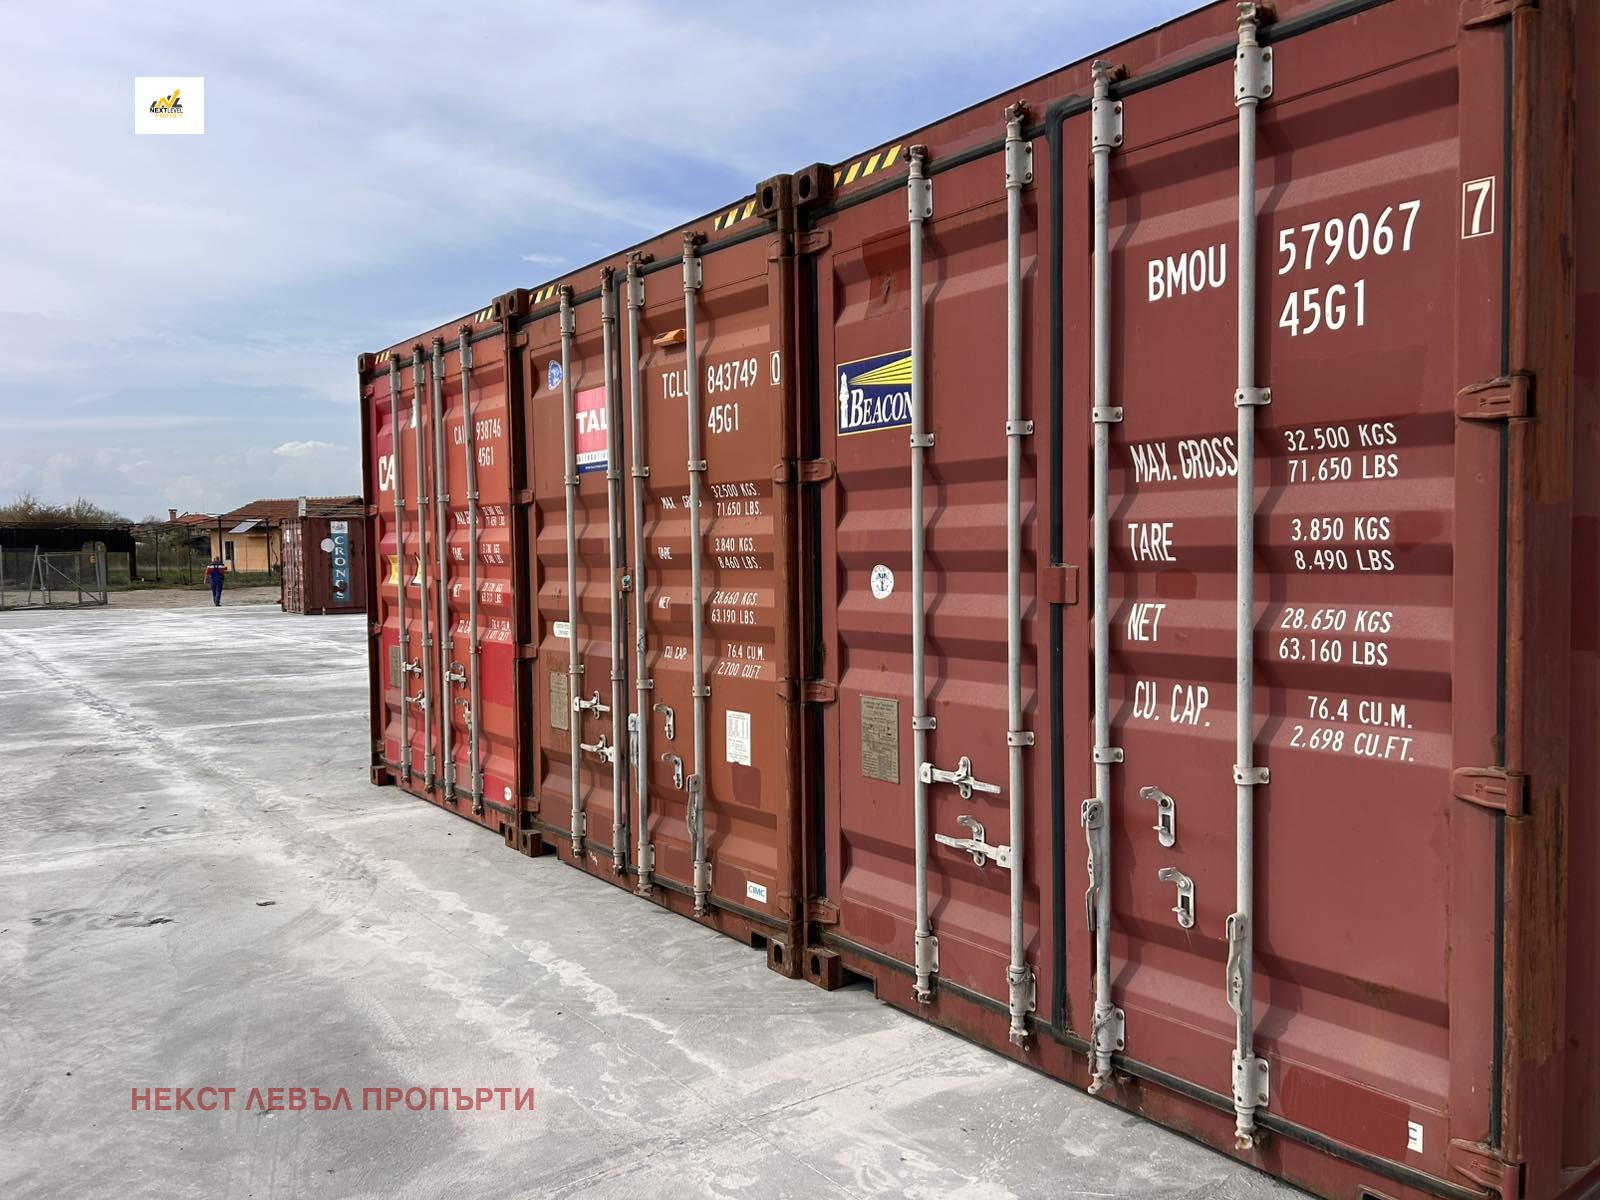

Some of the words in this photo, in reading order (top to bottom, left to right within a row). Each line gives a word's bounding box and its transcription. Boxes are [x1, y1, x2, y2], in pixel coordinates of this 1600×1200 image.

[1278, 199, 1421, 276] 579067
[1465, 179, 1491, 236] 7
[1148, 243, 1227, 302] BMOU
[1278, 279, 1366, 337] 45G1
[707, 357, 758, 394] 843749
[475, 416, 502, 441] 938746
[575, 407, 608, 435] TAL
[707, 402, 740, 434] 45G1
[1358, 423, 1397, 447] KGS
[477, 446, 494, 467] 45G1
[1129, 442, 1178, 484] MAX.
[1178, 436, 1239, 480] GROSS
[1362, 454, 1399, 480] LBS
[744, 500, 762, 516] LBS.
[1128, 522, 1176, 562] TARE
[1354, 516, 1391, 541] KGS
[1356, 549, 1395, 571] LBS
[1127, 602, 1166, 642] NET
[1354, 610, 1393, 634] KGS
[1352, 641, 1389, 667] LBS
[1132, 680, 1160, 721] CU.
[1169, 683, 1211, 728] CAP.
[1307, 695, 1349, 722] 76.4
[1358, 700, 1414, 729] CU.M.
[1353, 732, 1415, 763] CU.FT.
[748, 885, 766, 898] CIMC
